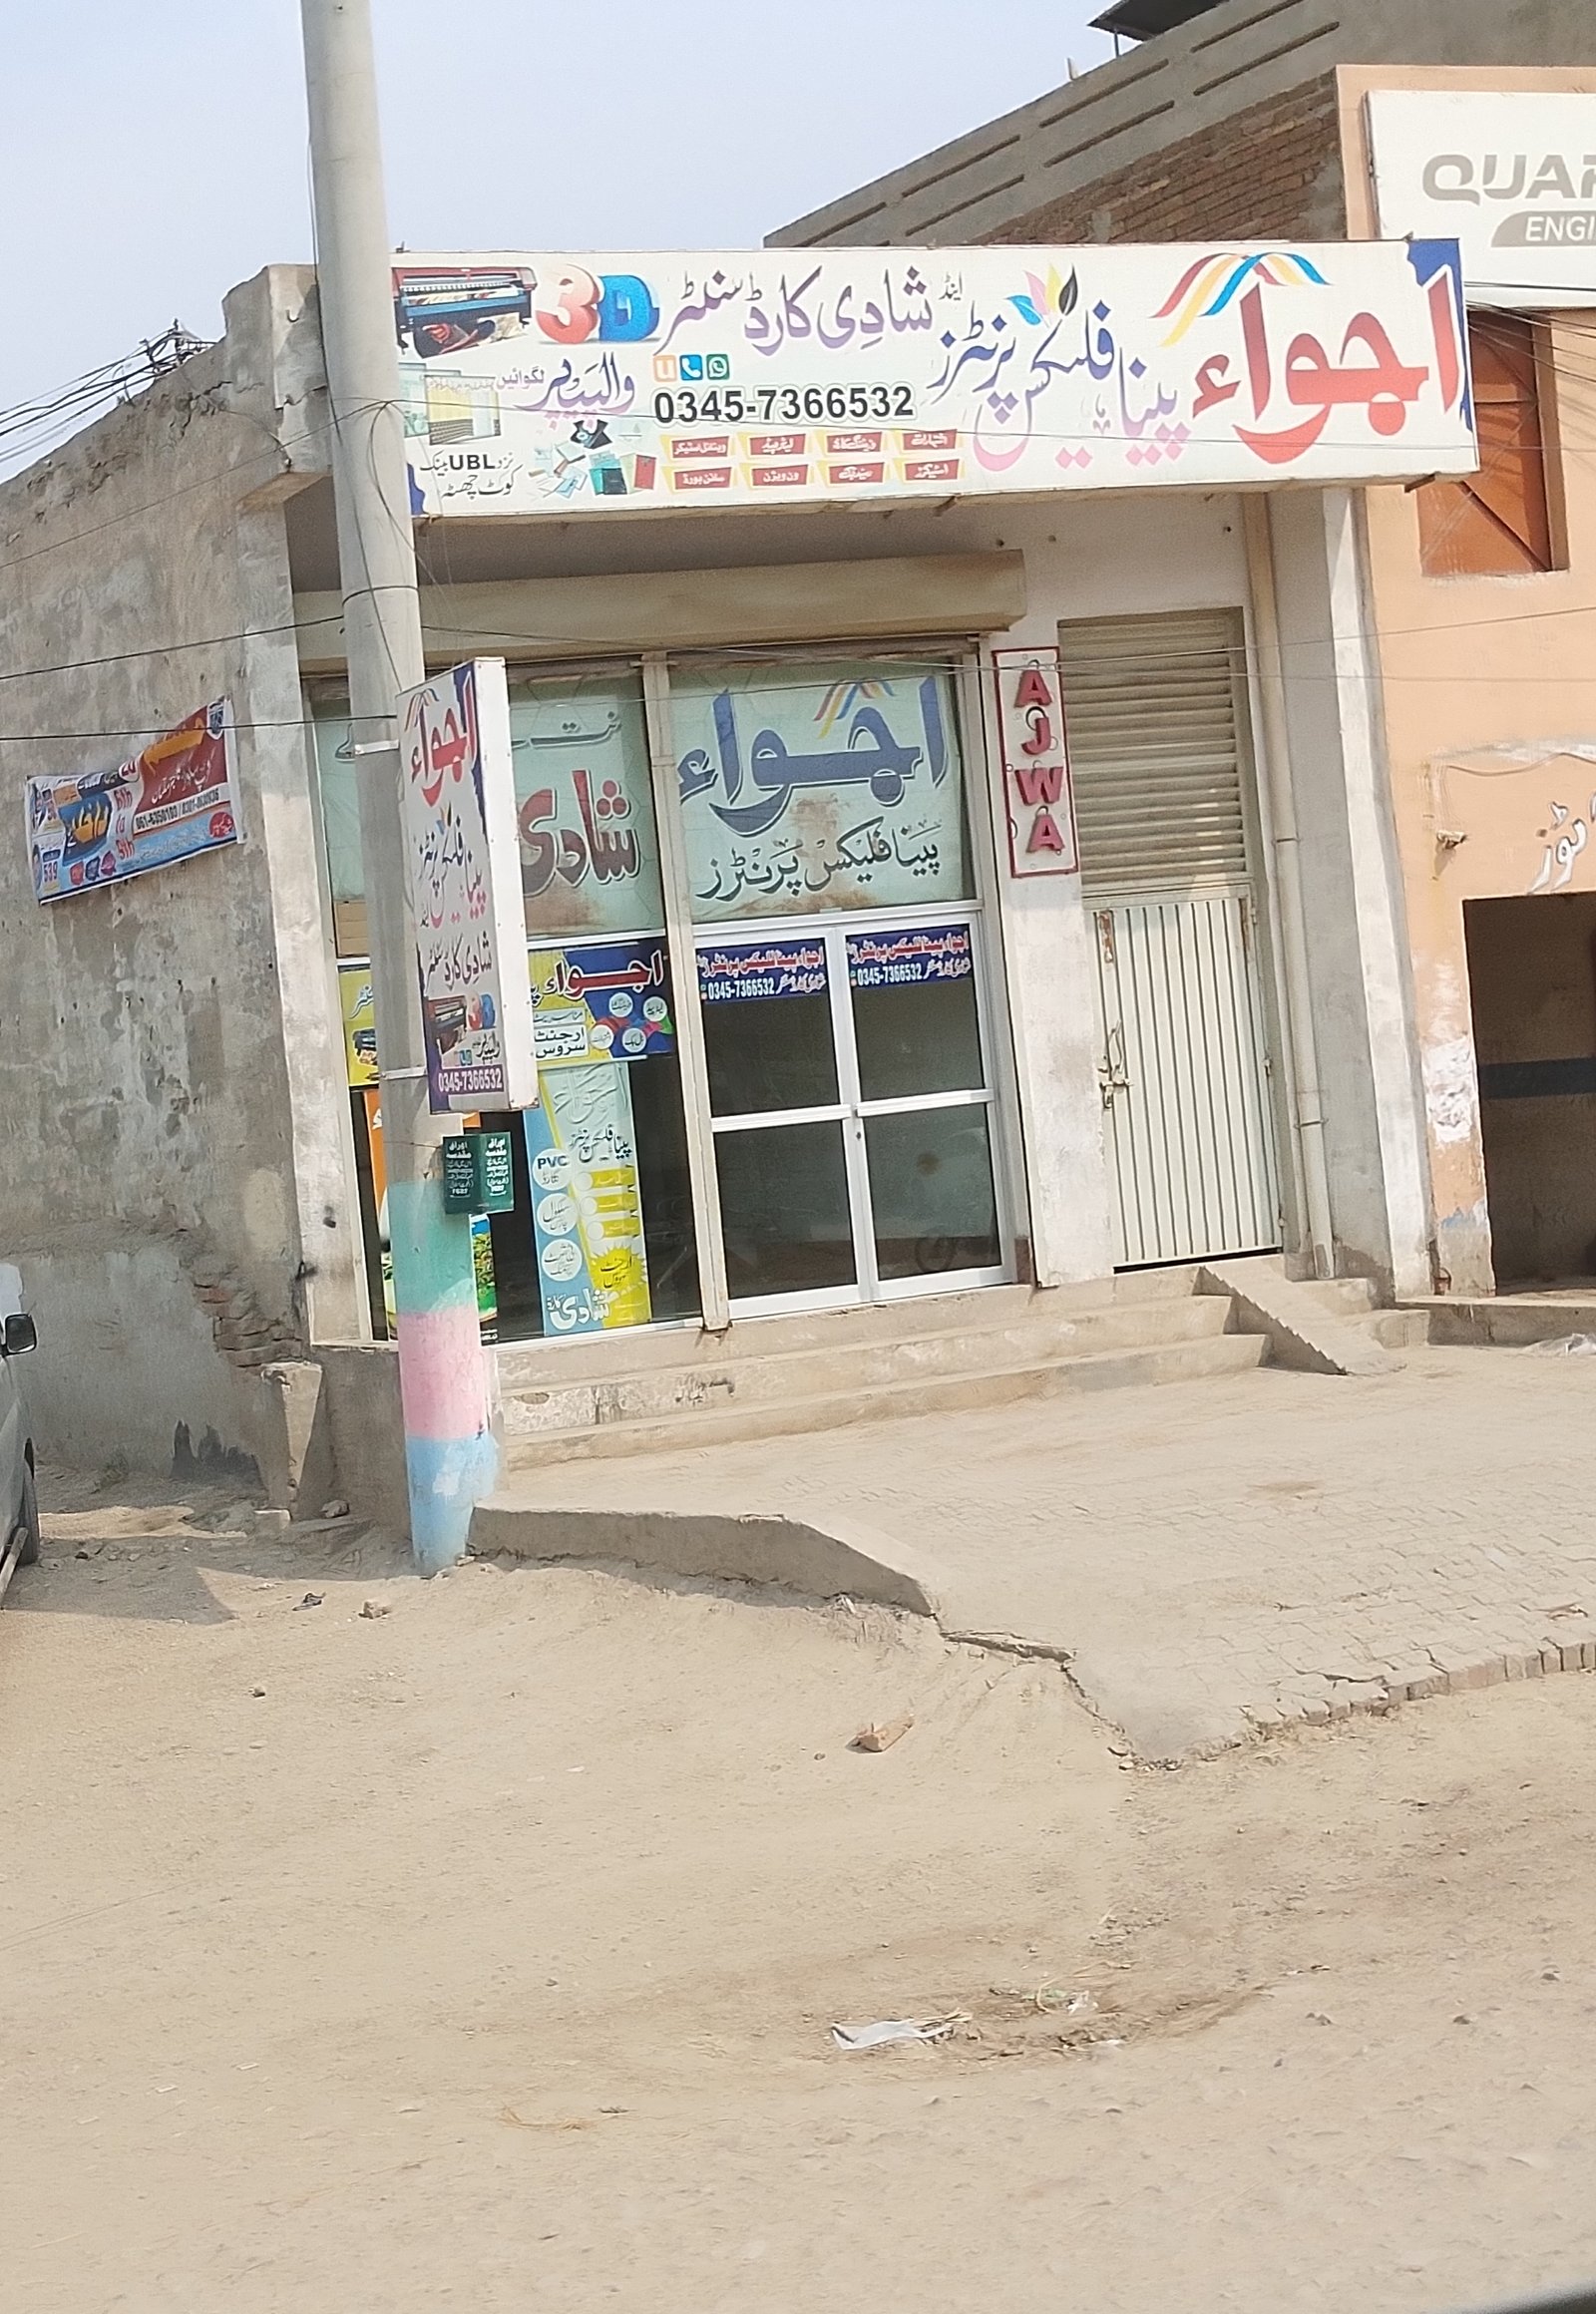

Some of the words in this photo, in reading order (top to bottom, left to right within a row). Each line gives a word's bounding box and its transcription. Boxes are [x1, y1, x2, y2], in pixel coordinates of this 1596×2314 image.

[535, 263, 660, 343] 3D
[744, 265, 823, 356] کارڈ
[1192, 266, 1459, 464] اجواء
[653, 385, 915, 425] 0345-7366532
[420, 451, 448, 476] بینک
[449, 454, 495, 471] UBL
[479, 464, 523, 497] کوٹ
[678, 676, 949, 838] اجواء
[543, 949, 664, 1001] اجواء
[707, 976, 775, 1000] 0345-7366532
[857, 963, 923, 986] 0345-7366532
[536, 1043, 587, 1058] سروس
[438, 1067, 504, 1093] 0345-7366532
[537, 1154, 570, 1170] PVC
